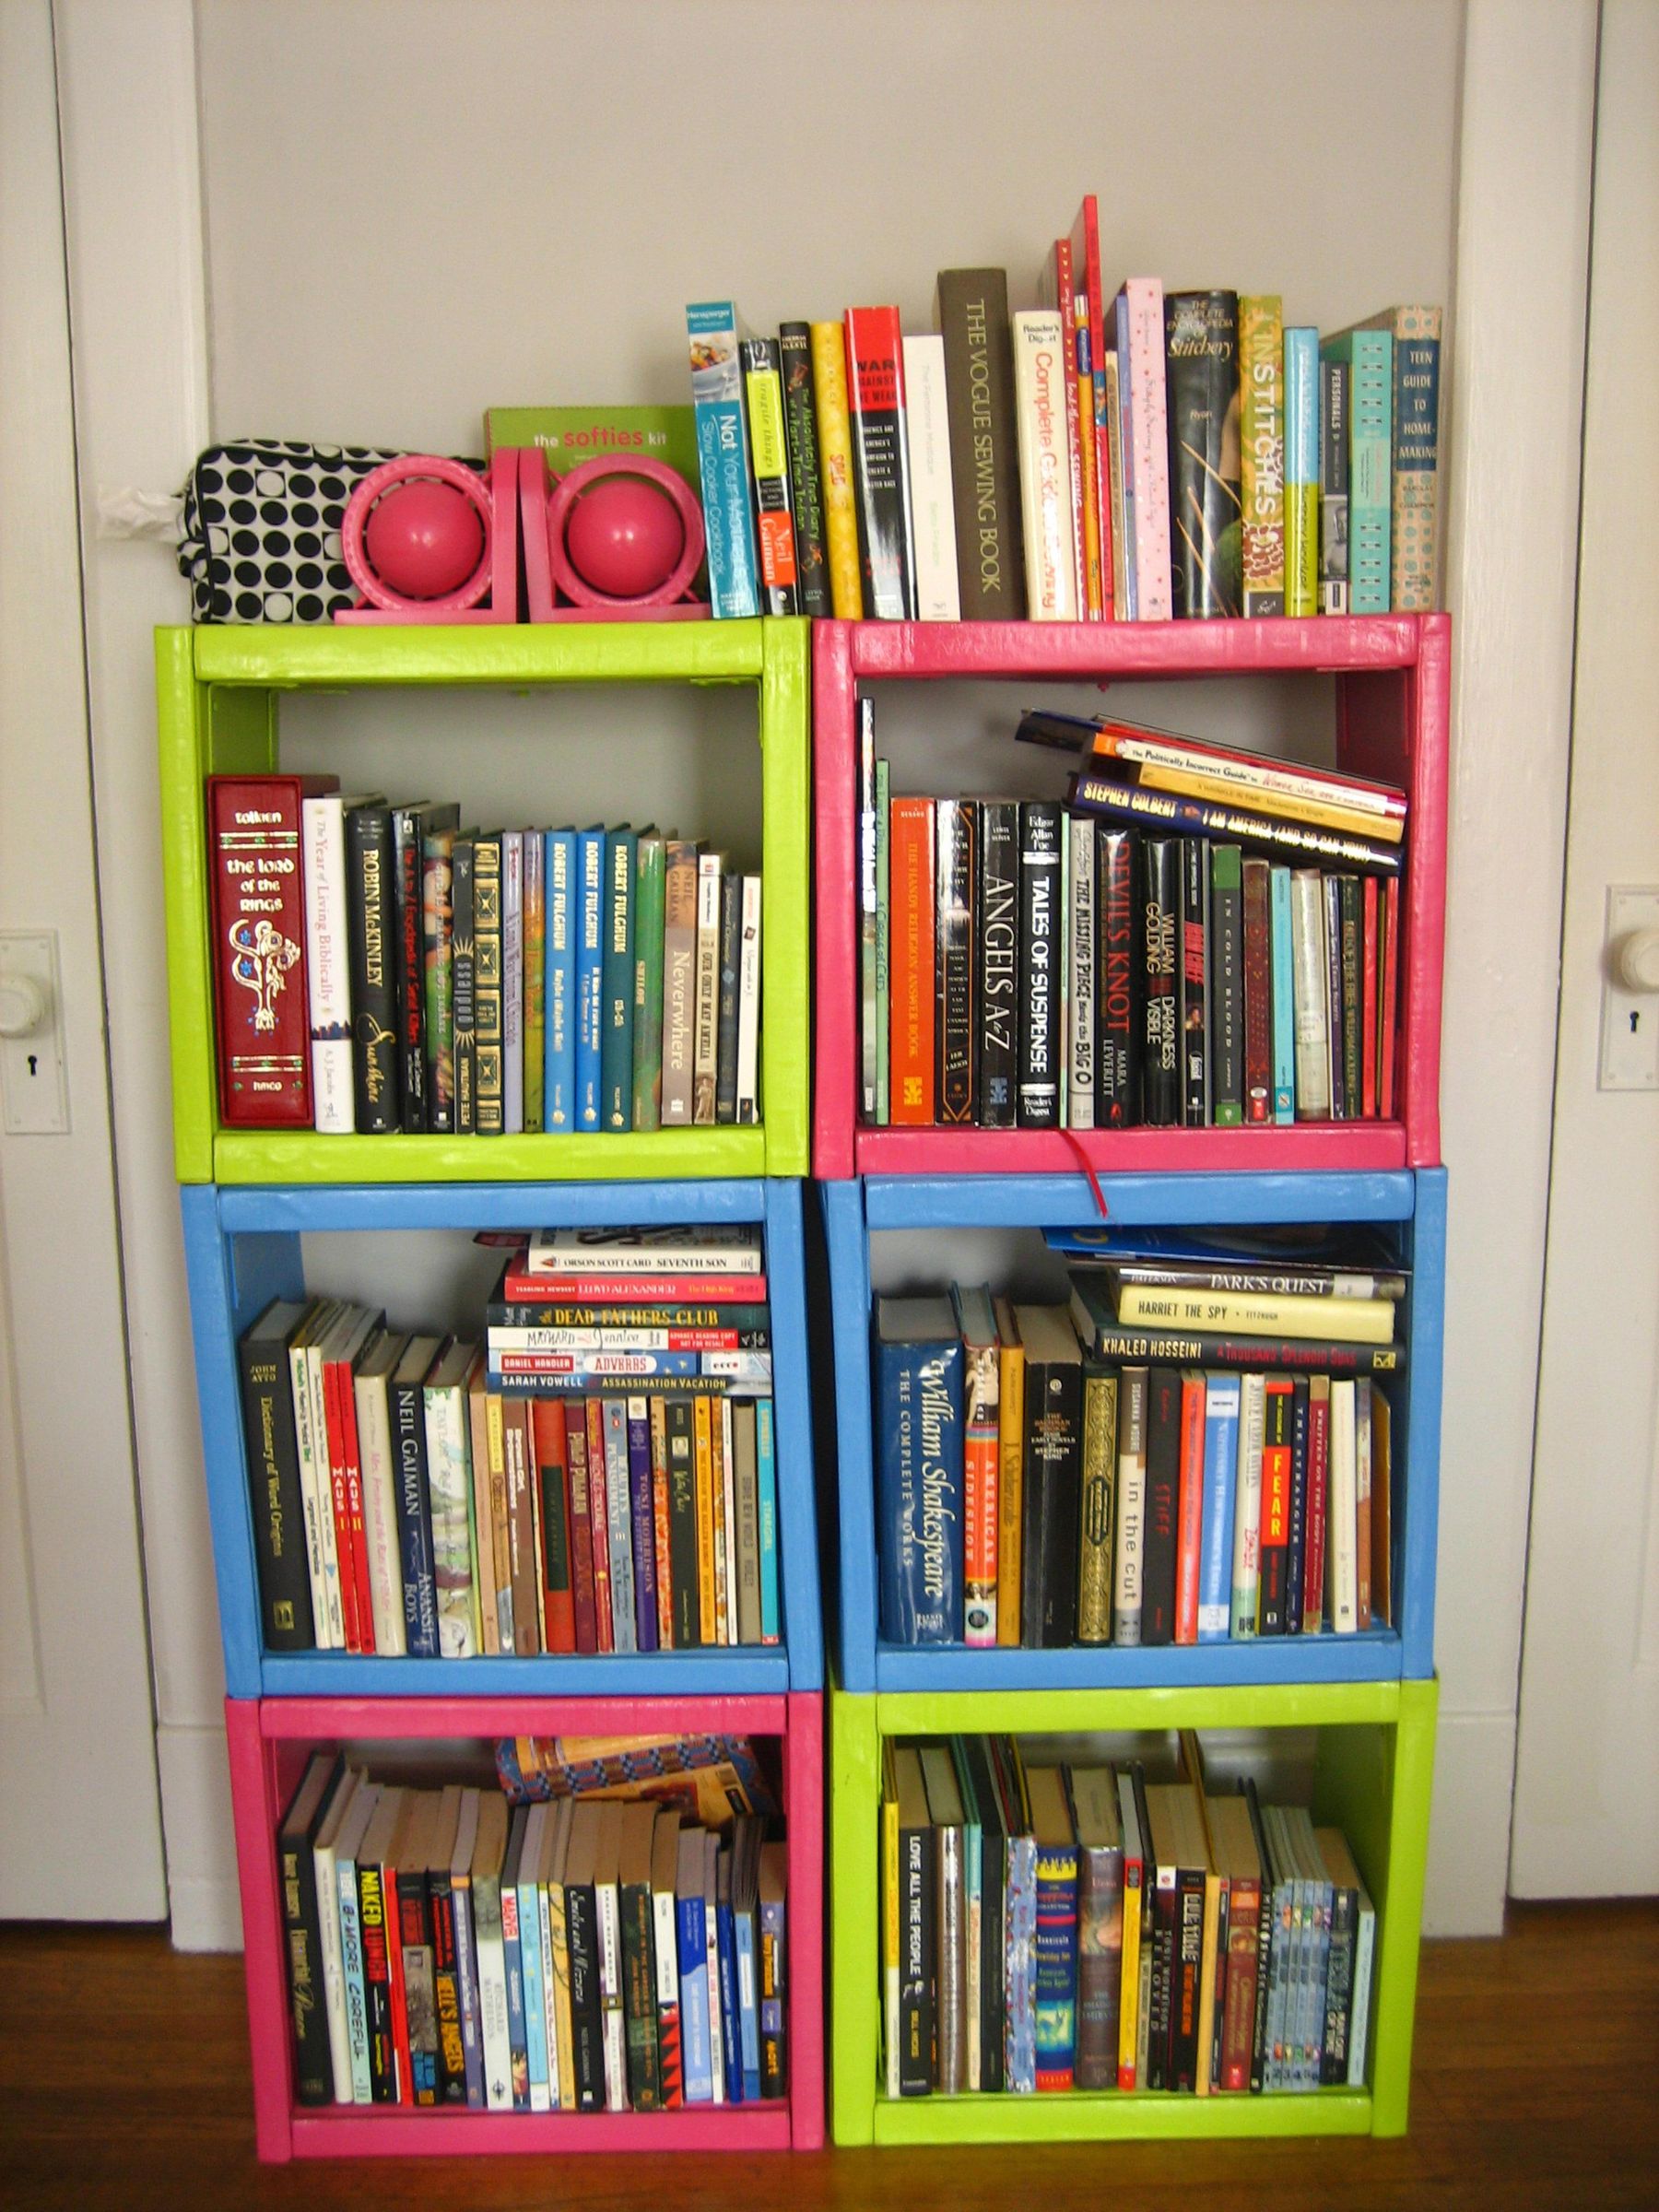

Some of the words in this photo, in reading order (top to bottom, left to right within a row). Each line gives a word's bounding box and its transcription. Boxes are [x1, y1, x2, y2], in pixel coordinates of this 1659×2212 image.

[968, 299, 986, 346] THE
[857, 359, 895, 372] WAR
[1167, 335, 1233, 362] Stitchery
[969, 348, 991, 429] VOGUE
[1034, 353, 1054, 447] Complete
[1331, 369, 1343, 429] PERSONALS
[1403, 374, 1431, 387] GUIDE
[1414, 398, 1427, 411] TO
[534, 434, 559, 447] the
[564, 427, 643, 447] softies
[648, 430, 667, 446] kit
[701, 421, 719, 453] Slow
[720, 415, 739, 450] Not
[801, 406, 817, 473] Absolutely
[705, 455, 721, 504] Cooker
[724, 453, 740, 494] Your
[973, 435, 996, 521] SEWING
[794, 489, 807, 532] Indian
[807, 505, 821, 540] Diary
[709, 506, 726, 576] Cookbook
[760, 518, 777, 581] Gaiman
[776, 529, 793, 563] Neil
[980, 528, 1001, 594] BOOK
[1145, 747, 1183, 767] Politically
[1186, 759, 1220, 774] Incorrect
[1222, 768, 1246, 780] Guide
[1084, 781, 1131, 807] STEPHEN
[1131, 793, 1178, 818] COLBERT
[316, 820, 327, 838] The
[1030, 816, 1053, 829] Edgar
[1030, 830, 1053, 840] Allan
[316, 840, 328, 871] Year
[363, 849, 380, 902] ROBIN
[553, 842, 566, 889] ROBERT
[585, 841, 598, 889] ROBERT
[615, 845, 628, 893] ROBERT
[908, 843, 918, 864] THE
[671, 869, 680, 923] GAIMAN
[684, 871, 693, 900] NEIL
[908, 866, 919, 908] HANDY
[1031, 877, 1049, 936] TALES
[1077, 879, 1090, 904] THE
[1106, 841, 1132, 942] DEVIL'S
[314, 887, 330, 931] Living
[553, 893, 566, 950] FULGHUM
[585, 891, 598, 948] FULGHUM
[615, 895, 628, 953] FULGHUM
[364, 904, 382, 988] McKINLEY
[908, 912, 919, 969] RELIGION
[984, 874, 1015, 995] ANGELS
[1030, 941, 1049, 970] OF
[1075, 907, 1092, 960] MISSING
[1146, 902, 1161, 974] GOLDING
[1161, 912, 1175, 974] WILLIAM
[316, 935, 335, 1002] Biblically
[1077, 962, 1092, 999] PIECE
[454, 961, 474, 1025] godless
[671, 950, 690, 1070] Neverwhere
[908, 971, 919, 1021] ANSWER
[984, 1002, 1010, 1022] A
[1106, 952, 1132, 1034] KNOT
[908, 1023, 920, 1058] BOOK
[984, 1030, 1010, 1051] Z
[1030, 972, 1048, 1073] SUSPENSE
[1147, 996, 1161, 1045] VISIBLE
[1160, 995, 1176, 1070] DARKNESS
[357, 1012, 396, 1104] Sunshine
[1076, 1041, 1091, 1067] BIG
[1102, 1039, 1114, 1098] LEVERITT
[1116, 1049, 1127, 1087] MARA
[460, 1056, 470, 1100] HAUTMAN
[1076, 1071, 1092, 1084] O
[461, 1101, 470, 1126] PETE
[563, 1258, 595, 1267] ORSON
[597, 1258, 626, 1267] SCOTT
[626, 1258, 653, 1267] CARD
[656, 1258, 703, 1267] SEVENTH
[706, 1258, 727, 1267] SON
[1207, 1273, 1268, 1291] PARK'S
[1272, 1276, 1327, 1294] QUEST
[579, 1284, 610, 1295] LLOYD
[610, 1285, 677, 1295] ALEXANDER
[1138, 1300, 1179, 1316] HARRIET
[1184, 1301, 1204, 1317] THE
[1207, 1302, 1228, 1319] SPY
[554, 1308, 594, 1324] DEAD
[676, 1308, 720, 1325] CLUB
[250, 1364, 276, 1373] JOHN
[504, 1359, 533, 1369] DANIEL
[535, 1359, 571, 1369] HANDLER
[594, 1356, 647, 1371] ADVERBS
[1102, 1337, 1147, 1356] KHALED
[1149, 1340, 1203, 1359] HOSSEINI
[252, 1373, 276, 1382] AYTO
[502, 1375, 537, 1387] SARAH
[539, 1375, 583, 1388] VOWELL
[602, 1378, 677, 1388] ASSASSINATION
[679, 1379, 727, 1389] VACATION
[900, 1370, 911, 1403] THE
[261, 1396, 277, 1463] Dictionary
[396, 1389, 413, 1433] NEIL
[920, 1359, 955, 1457] William
[1296, 1406, 1304, 1442] THE
[568, 1431, 585, 1465] PHILIP
[900, 1410, 912, 1500] COMPLETE
[1130, 1423, 1141, 1453] MOORE
[1315, 1408, 1324, 1462] WRITTEN
[267, 1477, 282, 1509] Word
[400, 1438, 419, 1515] GAIMAN
[607, 1443, 620, 1525] PUNISHMENT
[639, 1473, 649, 1510] TONI
[1128, 1481, 1142, 1502] in
[1271, 1453, 1283, 1536] FEAR
[1315, 1465, 1323, 1481] ON
[965, 1460, 976, 1562] SIDESHOW
[984, 1459, 995, 1564] AMERICAN
[1154, 1483, 1171, 1537] STIFF
[1293, 1448, 1302, 1545] STRANGER
[267, 1512, 285, 1557] Origins
[901, 1502, 914, 1567] WORKS
[912, 1461, 955, 1597] Shakespeare
[1125, 1513, 1139, 1552] the
[642, 1515, 653, 1594] MORRISON
[404, 1583, 418, 1623] BOYS
[419, 1571, 433, 1634] ANANSI
[1124, 1562, 1138, 1601] cut
[910, 1836, 921, 1870] LOVE
[360, 1871, 382, 1925] NAKED
[910, 1872, 921, 1897] ALL
[503, 1895, 519, 1941] MARVEL
[571, 1890, 588, 1932] Smoke
[910, 1899, 921, 1924] THE
[342, 1904, 360, 1973] B-MORE
[364, 1927, 387, 1983] LUNCH
[910, 1924, 921, 1975] PEOPLE
[437, 1976, 459, 2020] HELL'S
[1151, 1929, 1162, 2032] BELOVED
[441, 2022, 465, 2074] ANGELS
